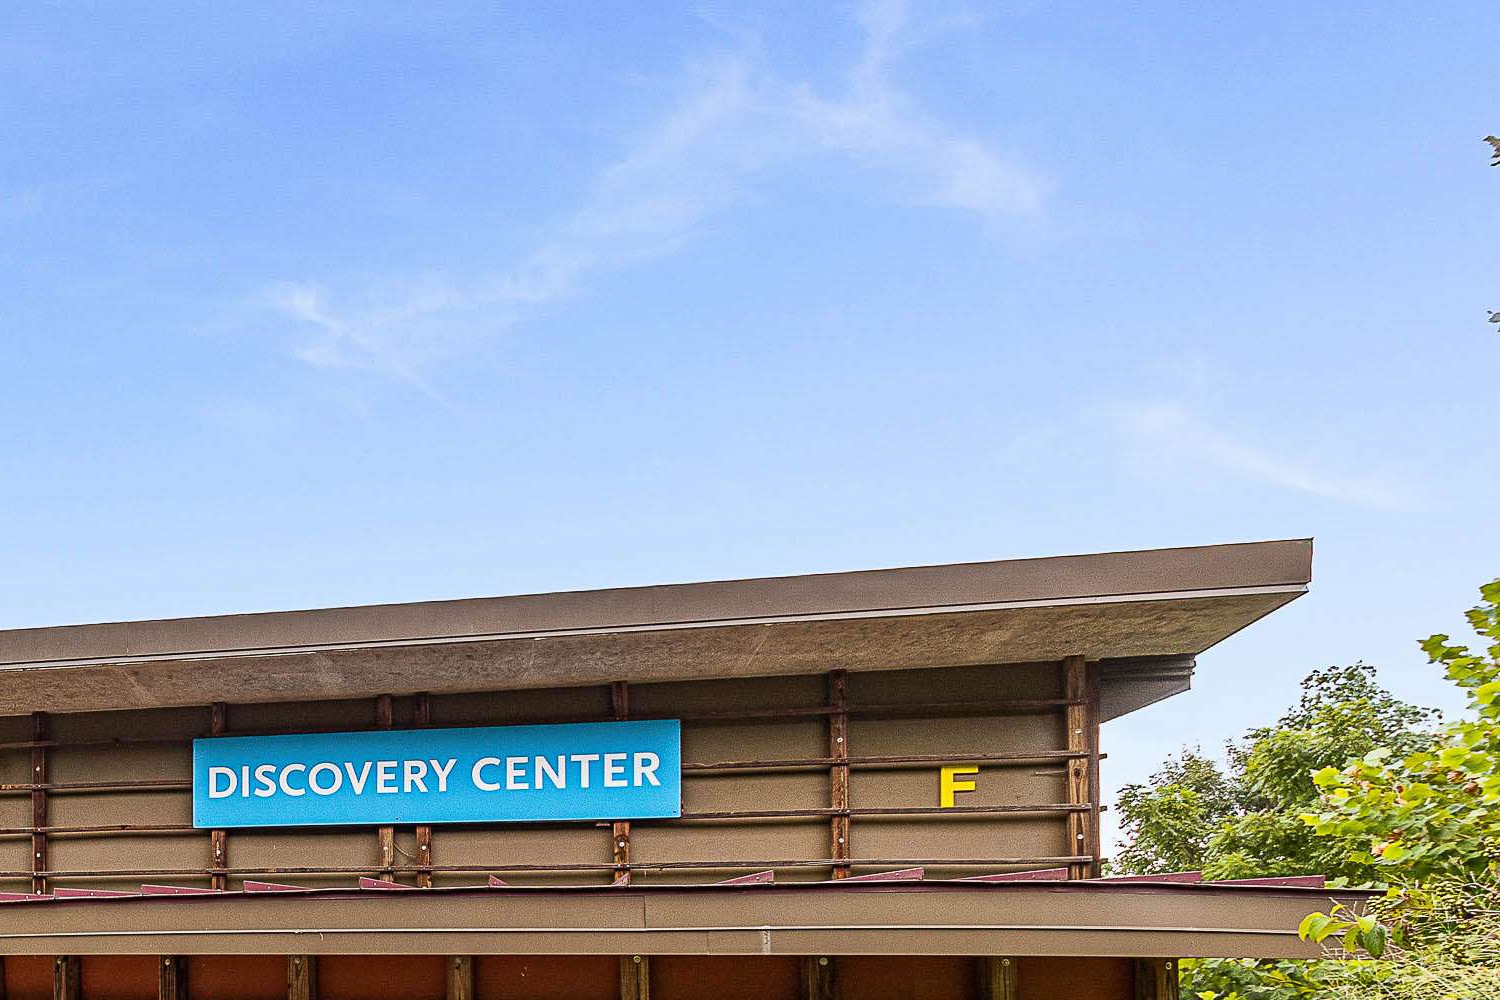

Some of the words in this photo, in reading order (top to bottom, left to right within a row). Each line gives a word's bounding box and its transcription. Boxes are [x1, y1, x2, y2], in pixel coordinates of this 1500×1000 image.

[207, 759, 457, 799] DISCOVERY
[471, 751, 661, 793] CENTER
[940, 766, 979, 808] F
